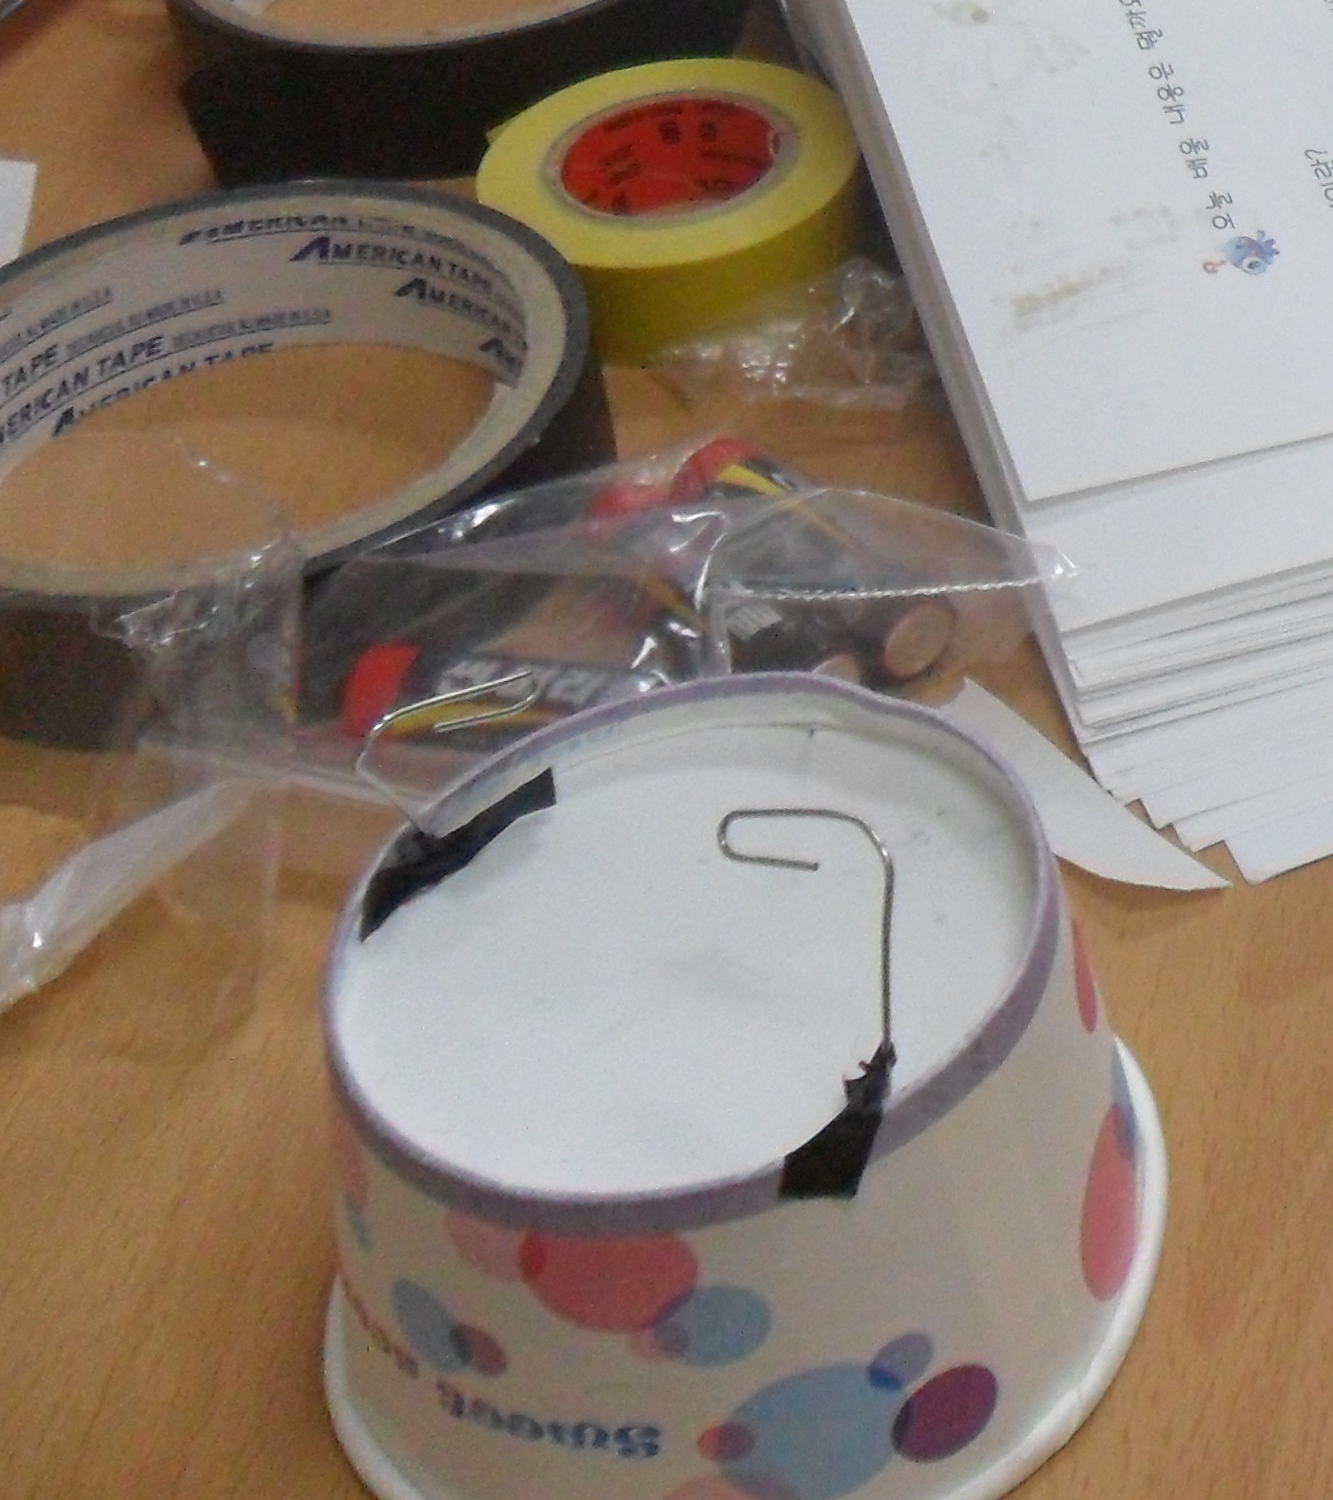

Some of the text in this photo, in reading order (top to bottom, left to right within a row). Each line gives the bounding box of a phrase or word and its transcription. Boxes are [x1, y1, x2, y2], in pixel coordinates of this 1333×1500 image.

[1146, 61, 1185, 125] 내용은
[1177, 136, 1210, 180] 배울
[1204, 190, 1236, 230] 오늘
[288, 235, 442, 271] AMERICAN
[96, 334, 164, 382] TAPE
